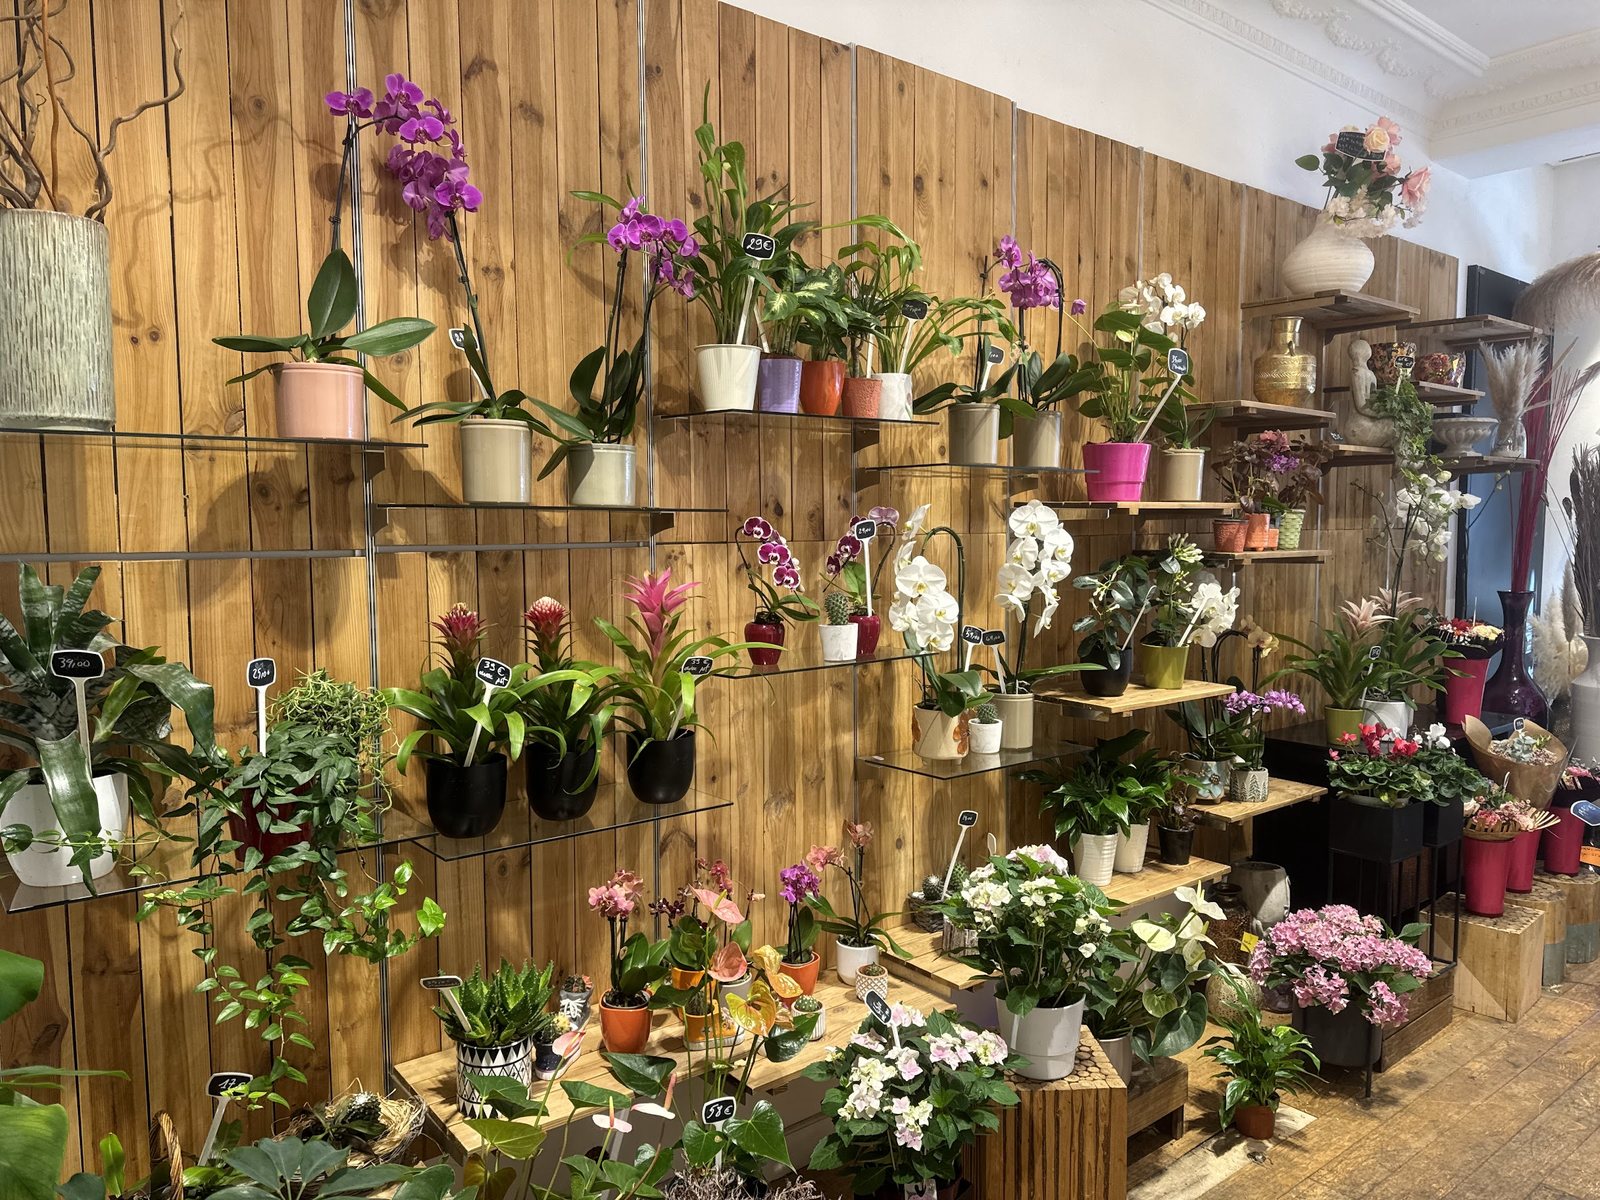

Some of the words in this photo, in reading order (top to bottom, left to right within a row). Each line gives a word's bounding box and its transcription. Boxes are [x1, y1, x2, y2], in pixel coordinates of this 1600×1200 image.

[747, 237, 773, 251] 29€
[58, 657, 91, 669] 39,00
[497, 666, 506, 677] €
